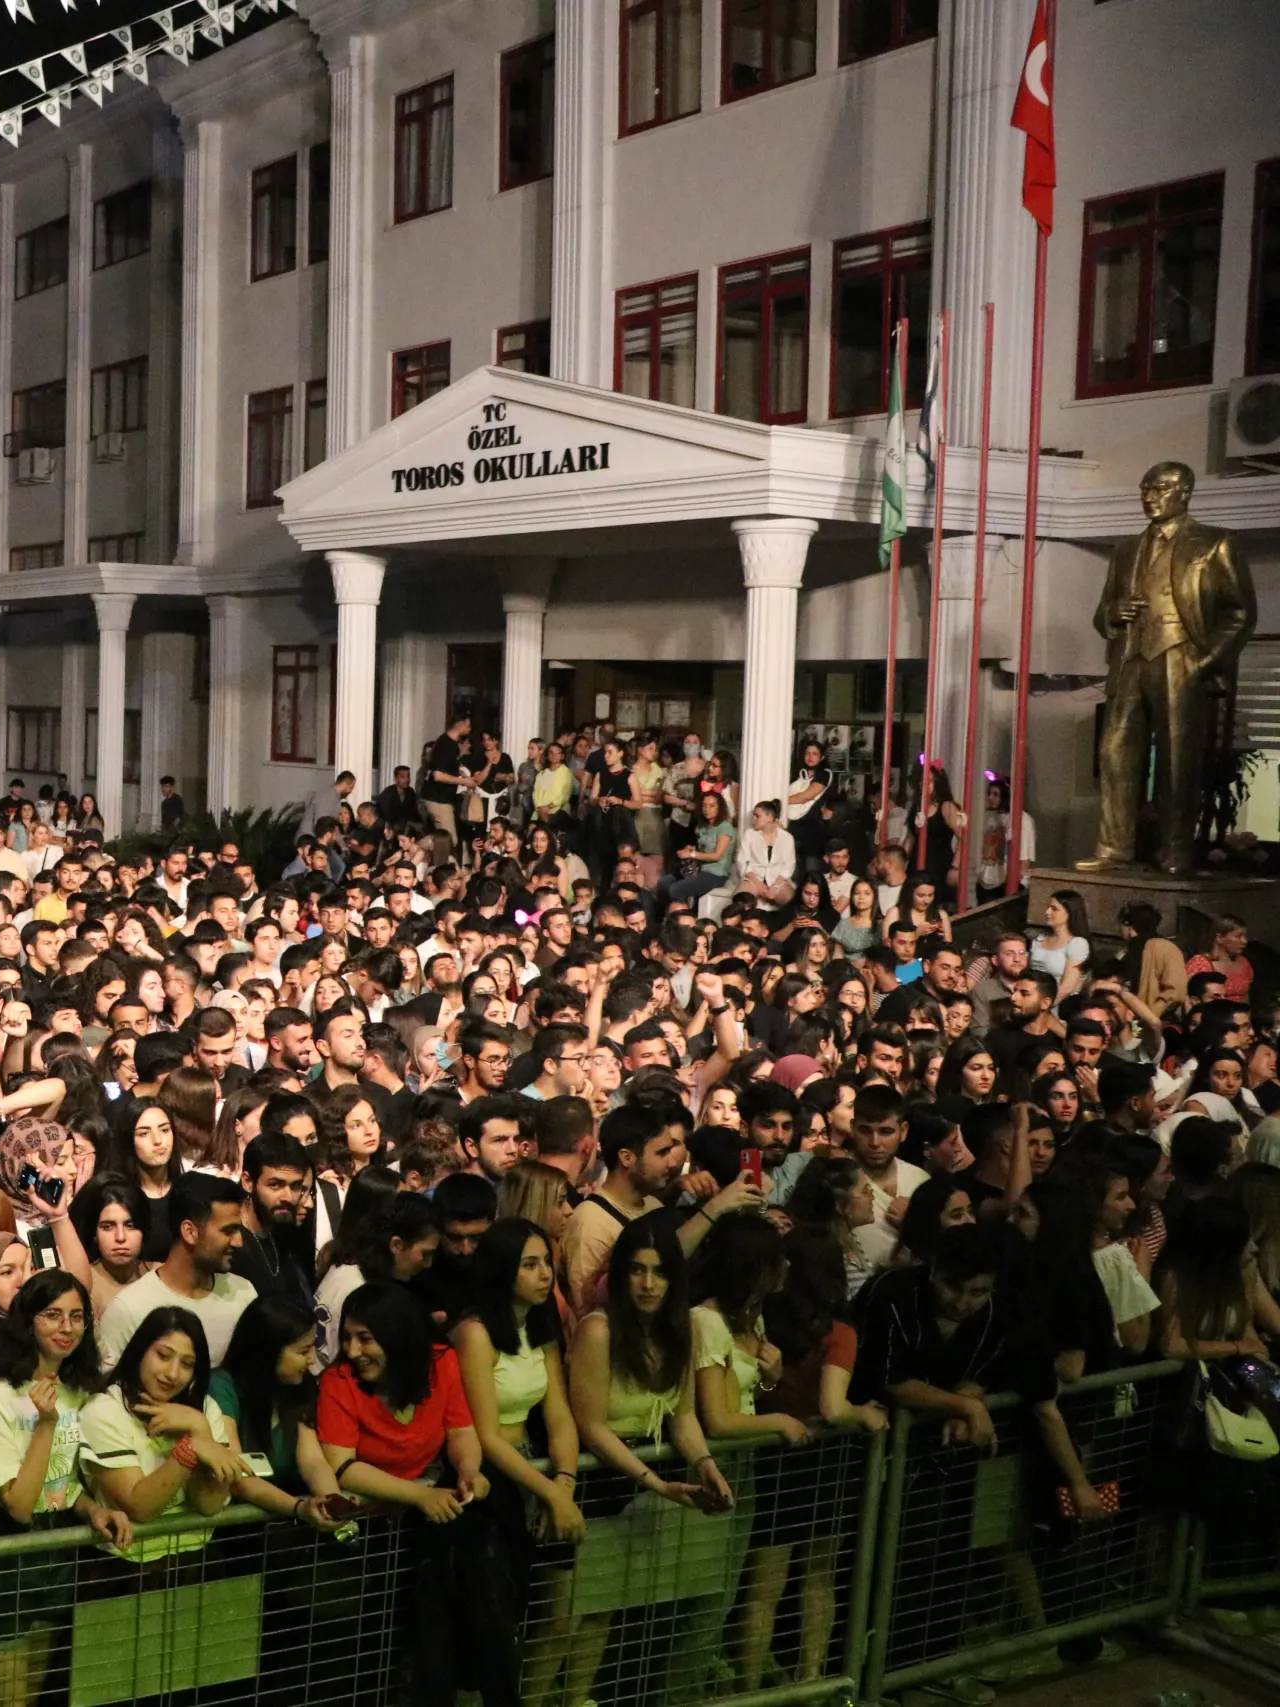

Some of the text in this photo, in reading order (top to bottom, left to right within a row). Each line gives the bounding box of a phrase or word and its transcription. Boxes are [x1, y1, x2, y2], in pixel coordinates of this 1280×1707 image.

[483, 402, 506, 422] TC
[467, 425, 521, 450] ÖZEL
[392, 442, 610, 493] TOROS OKULLARI
